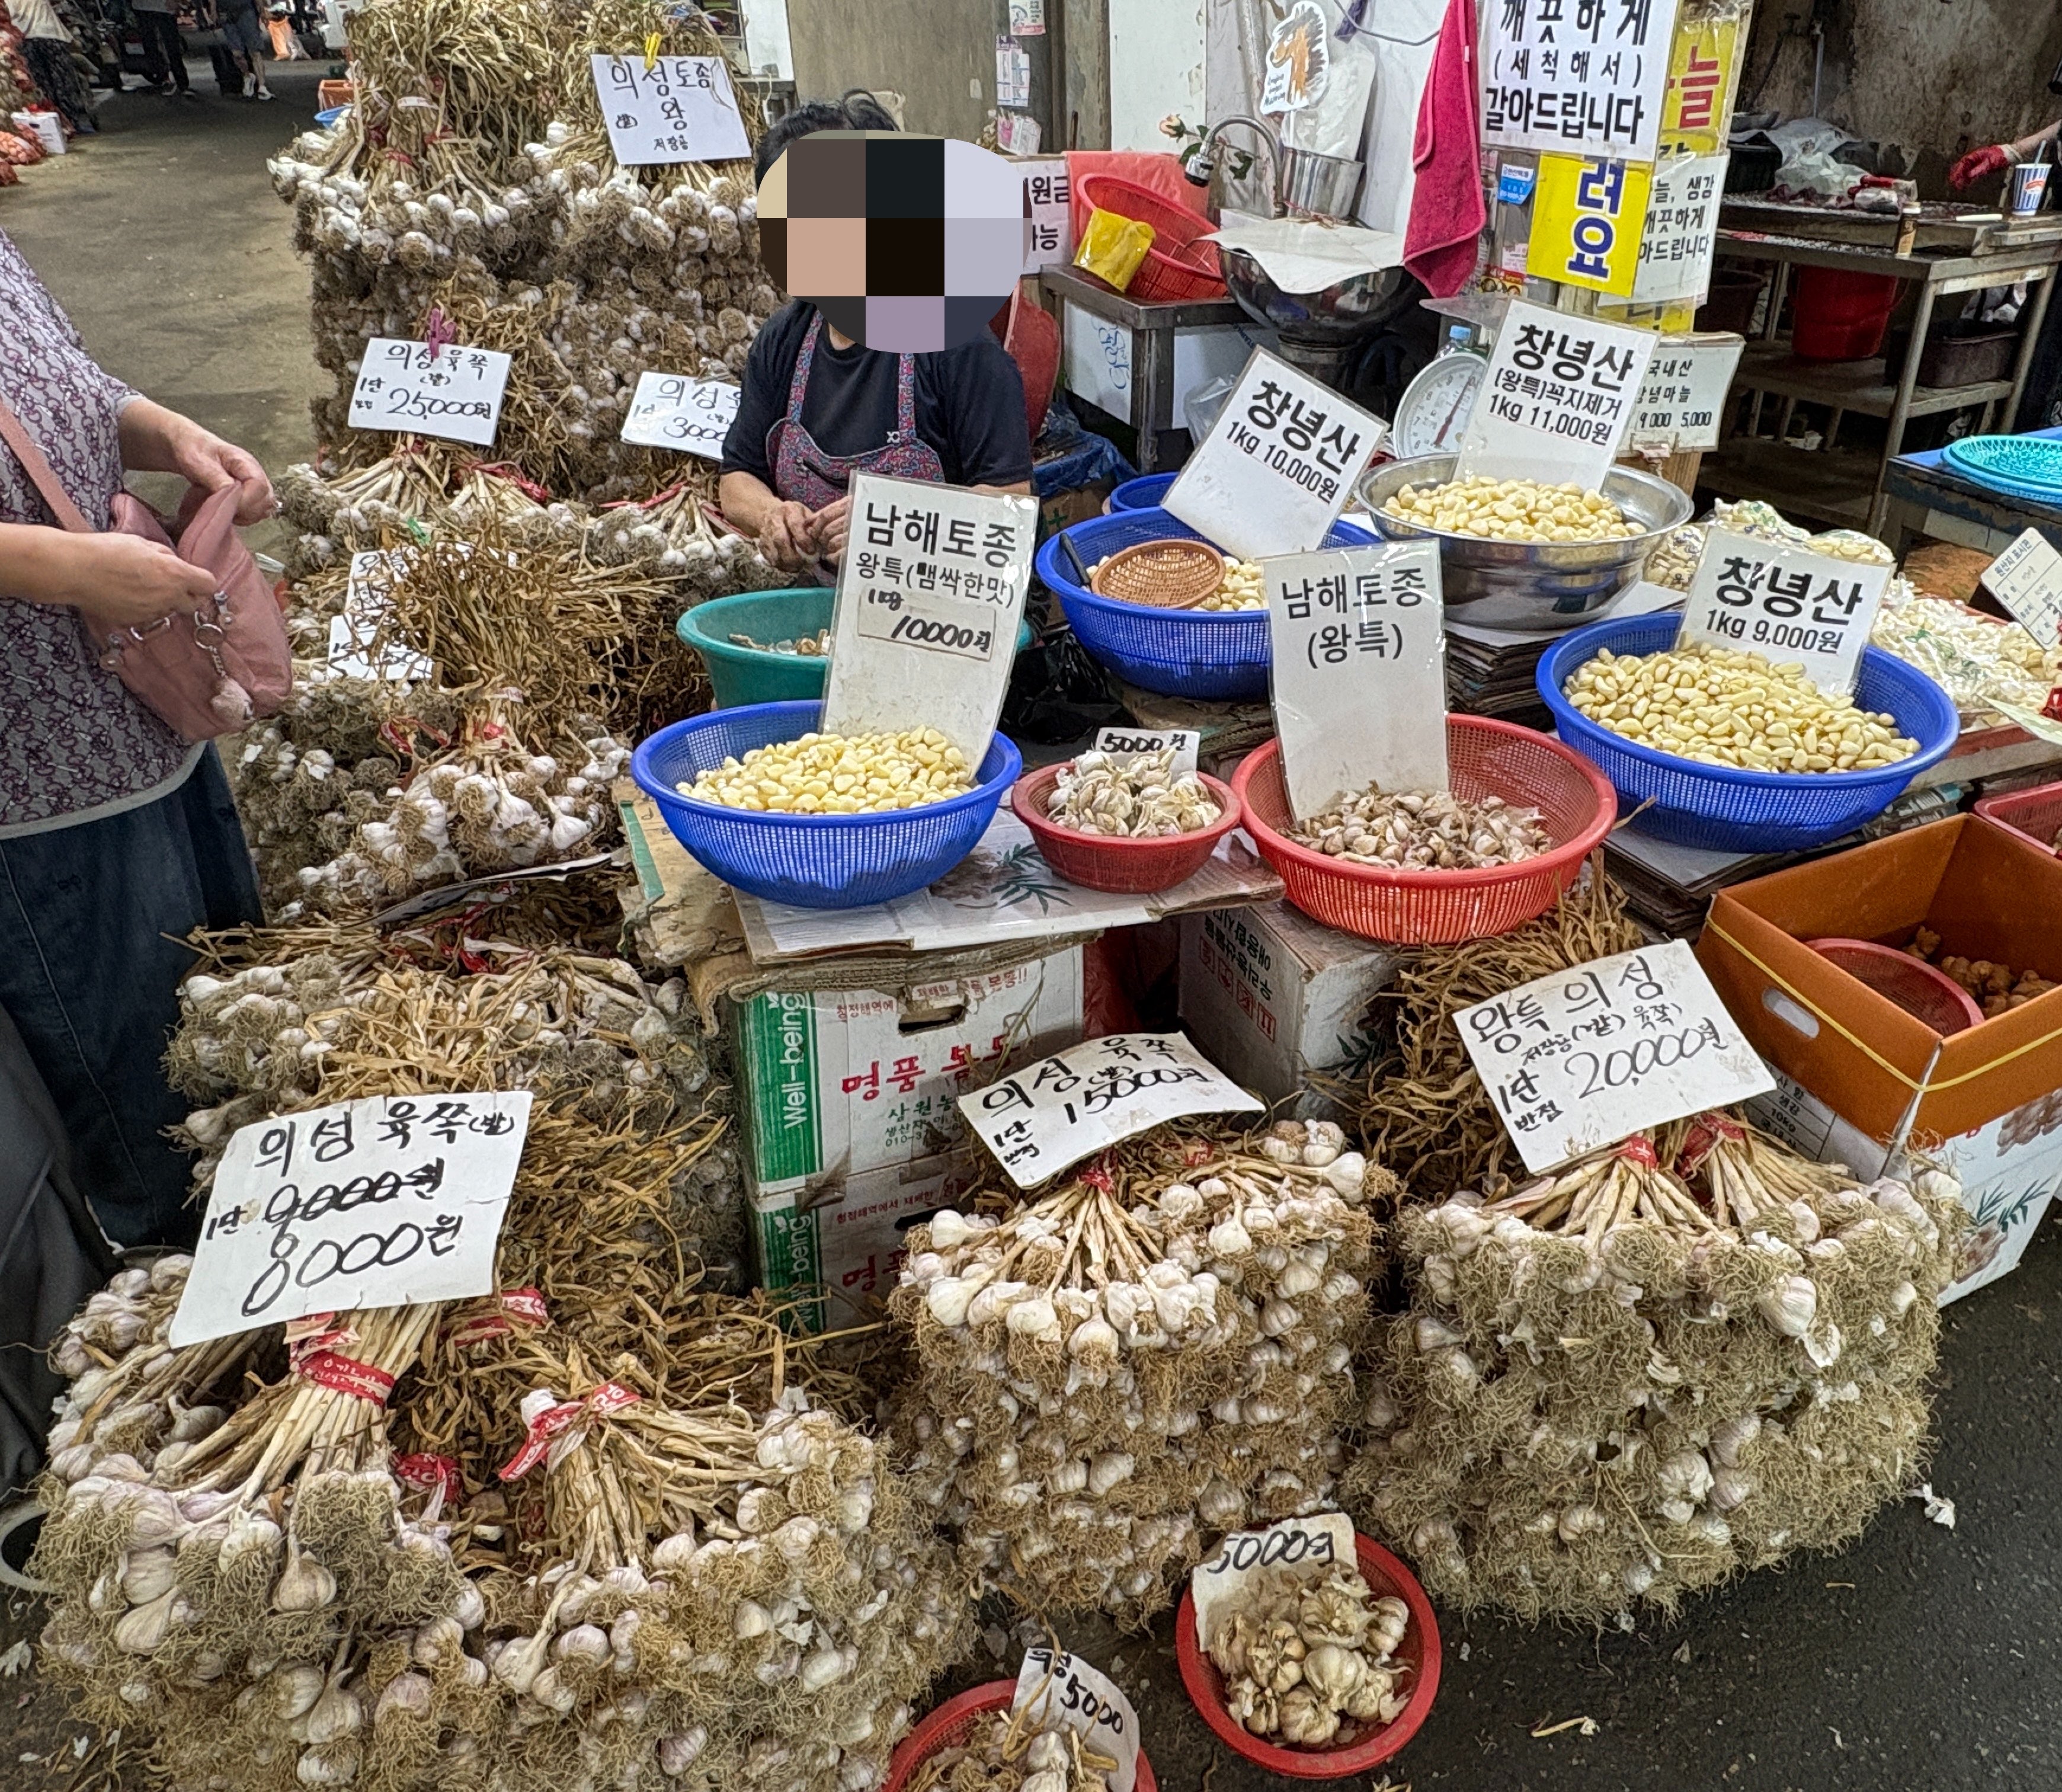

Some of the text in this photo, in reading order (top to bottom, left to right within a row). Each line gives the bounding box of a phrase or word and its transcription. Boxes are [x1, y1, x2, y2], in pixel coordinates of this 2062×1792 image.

[660, 97, 688, 130] 왕
[1485, 85, 1644, 144] 갈아드립니다
[1669, 46, 1720, 129] 늘
[1024, 175, 1070, 205] 원금
[1687, 174, 1715, 200] 생강
[1513, 324, 1634, 393] 창녕산
[1648, 359, 1693, 377] 국내산
[655, 379, 719, 409] 의성
[1488, 393, 1523, 422] 1kg
[1531, 407, 1613, 446] 11,000원
[1247, 380, 1361, 475] 창녕산
[1226, 421, 1340, 505] 1kg 10,000원
[866, 502, 1017, 568] 남해토종
[1281, 568, 1427, 620] 남해토종
[1715, 556, 1864, 626] 창녕산
[1308, 620, 1403, 670] (왕특)
[1706, 609, 1844, 655] 1kg 9,000원
[1469, 954, 1664, 1054] 왕특 의성
[780, 992, 808, 1129] Well-being
[841, 1055, 926, 1102] 명품
[982, 1057, 1081, 1118] 의성
[1497, 1068, 1541, 1115] 1단
[254, 1110, 354, 1178] 의성
[993, 1119, 1033, 1147] 1단
[205, 1205, 246, 1241] 1단
[242, 1215, 464, 1317] 8000원
[1059, 1673, 1123, 1735] 5000
